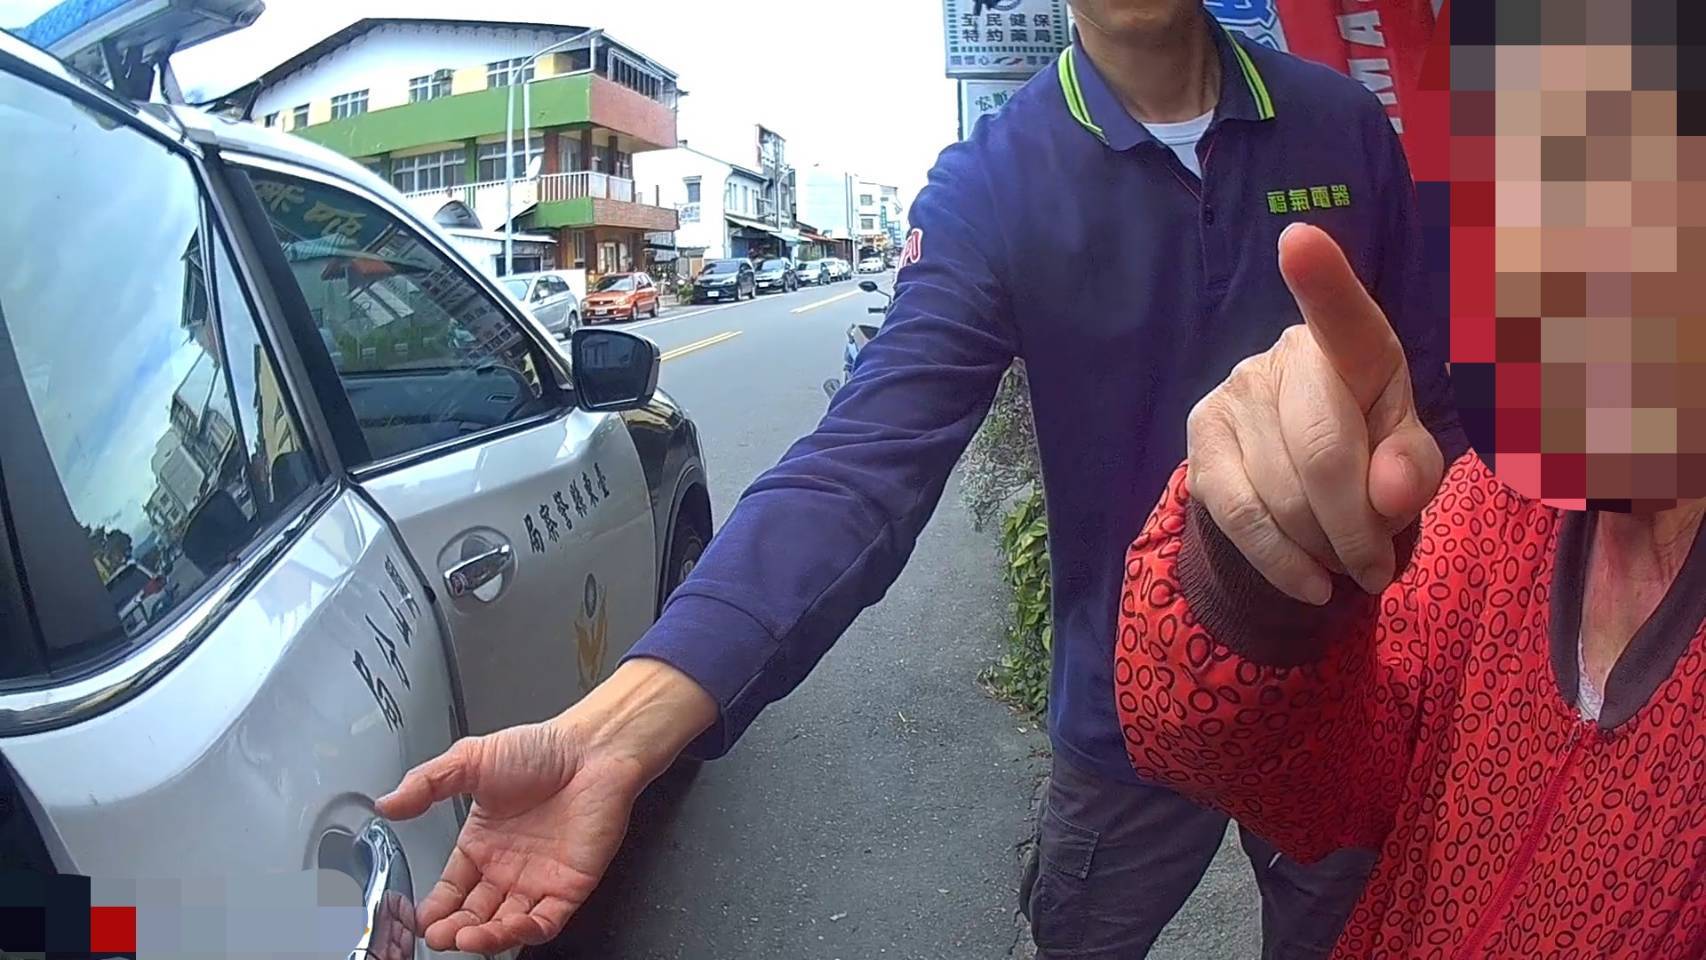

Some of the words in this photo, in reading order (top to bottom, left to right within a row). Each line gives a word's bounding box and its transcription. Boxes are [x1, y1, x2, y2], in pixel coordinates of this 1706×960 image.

[961, 13, 1050, 27] 全民健保
[962, 29, 1051, 42] 特約藥局
[1266, 184, 1350, 213] 福氣電器
